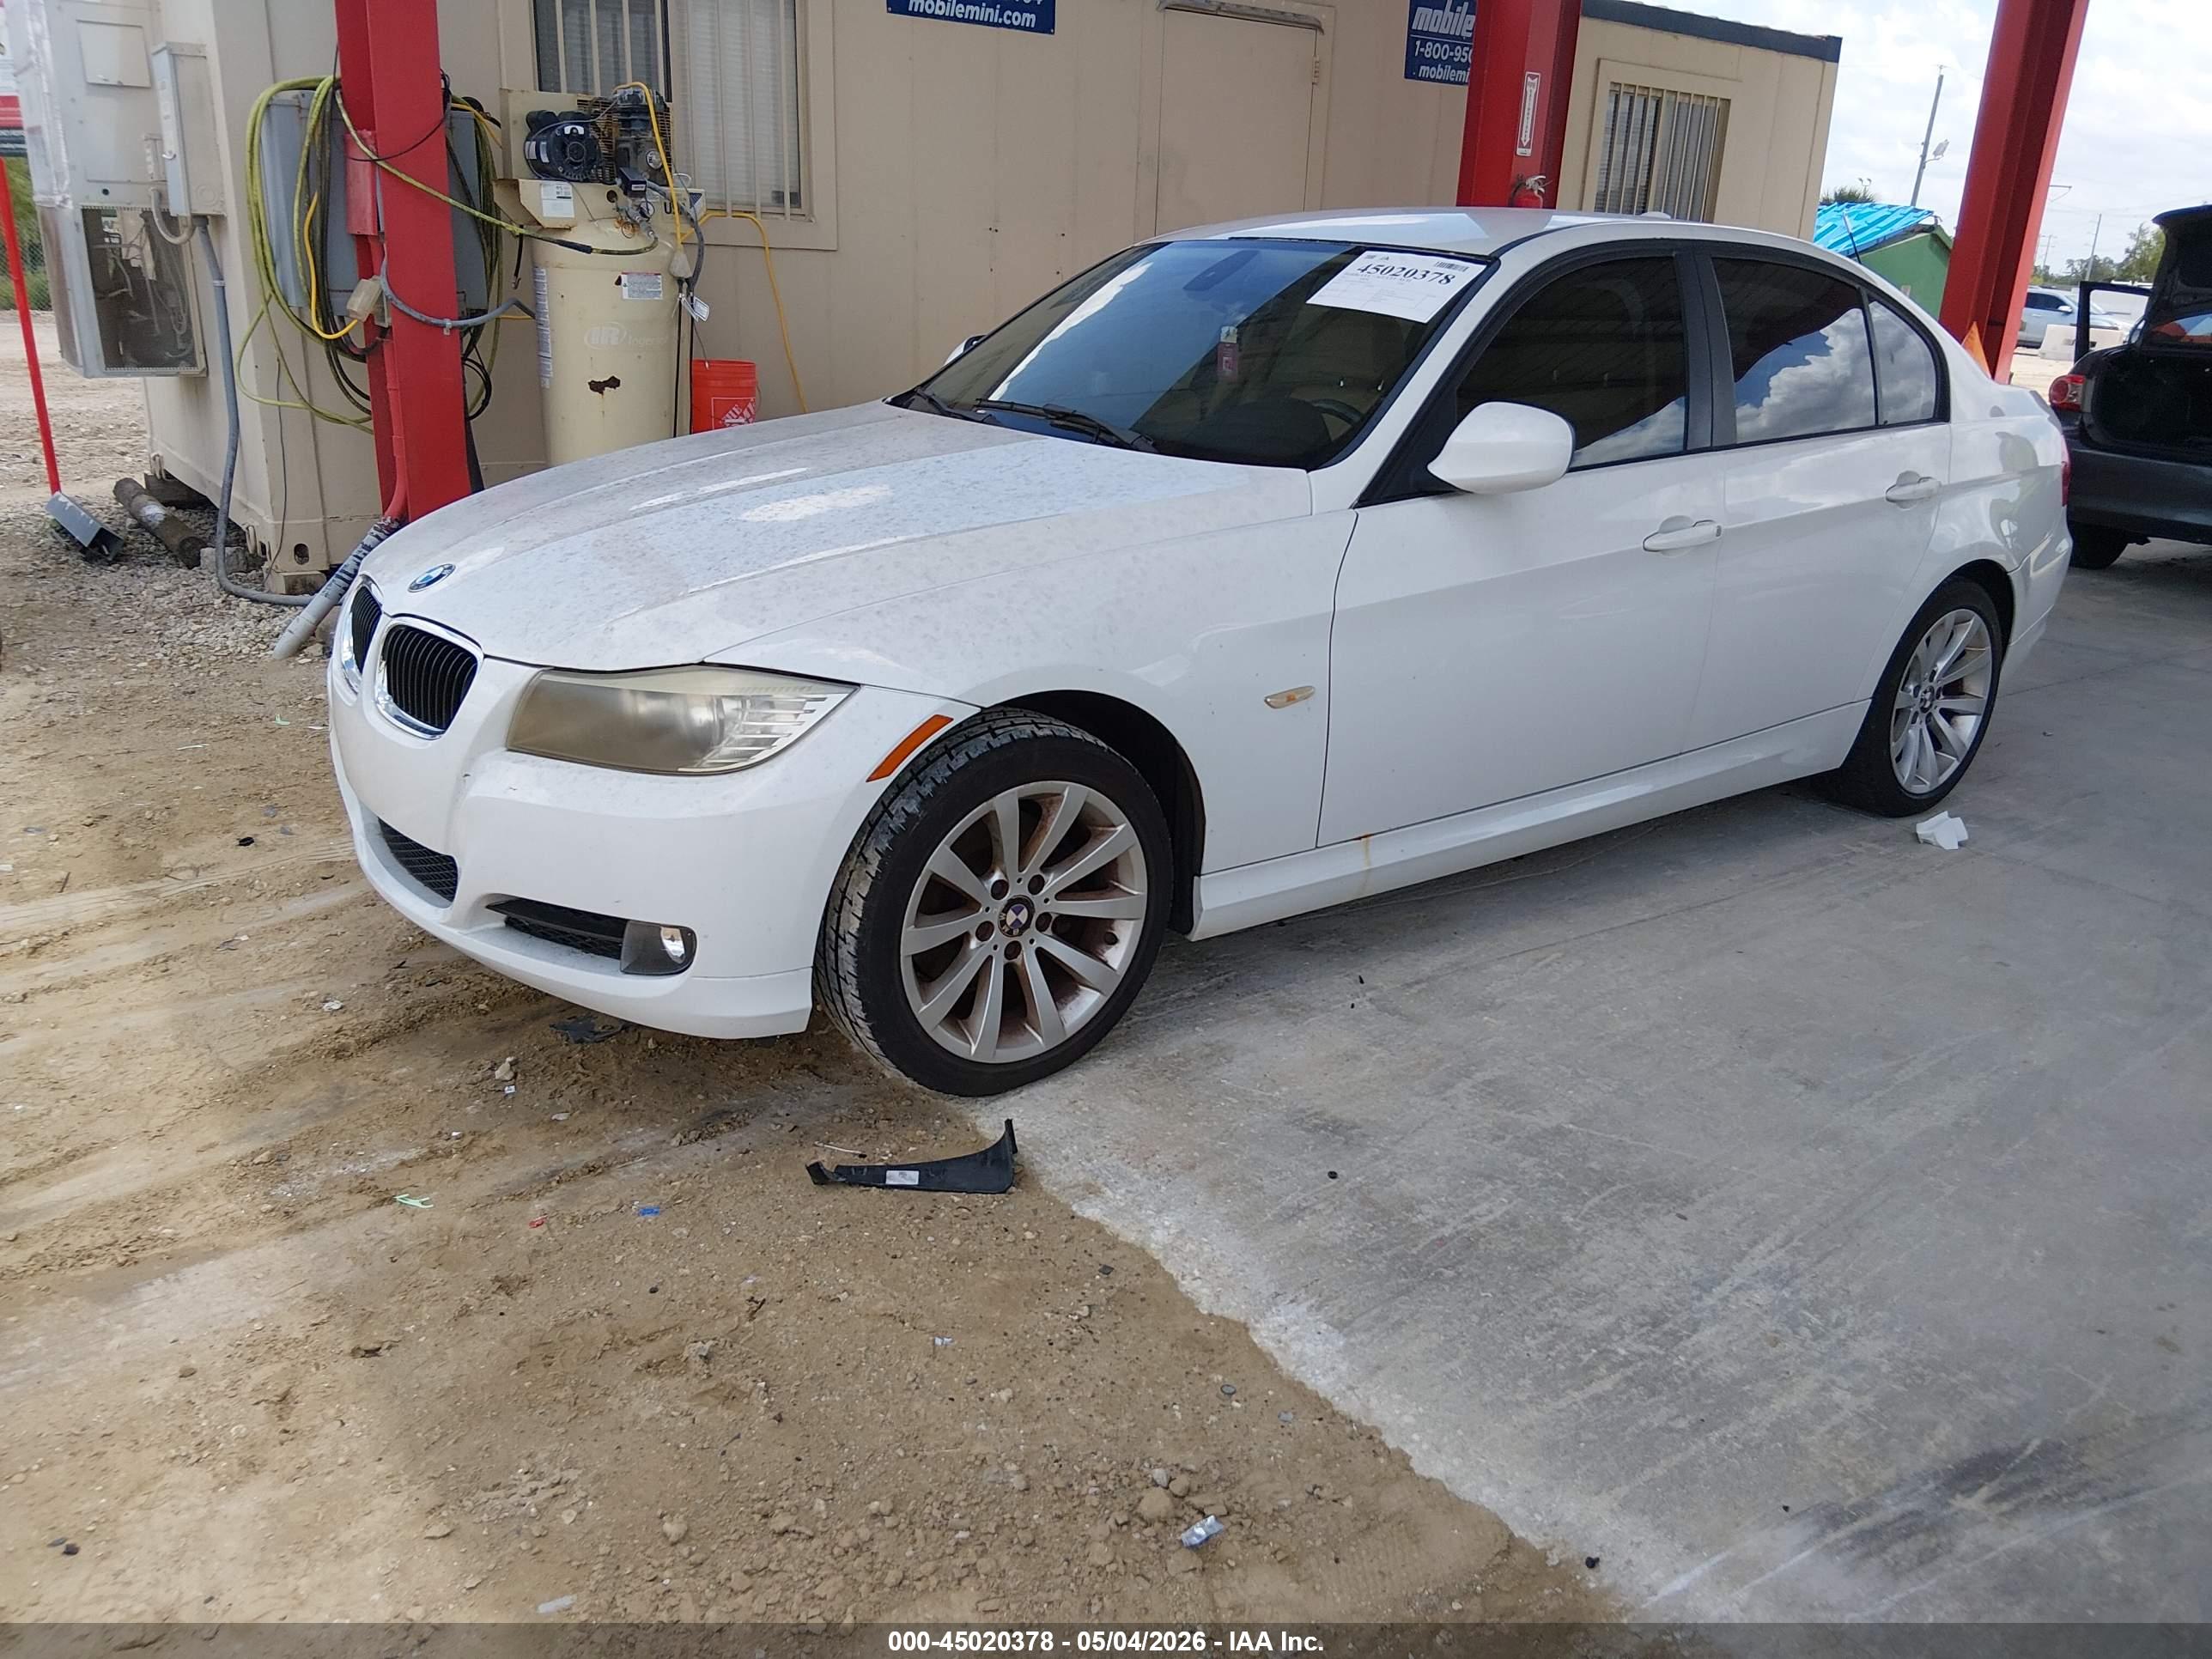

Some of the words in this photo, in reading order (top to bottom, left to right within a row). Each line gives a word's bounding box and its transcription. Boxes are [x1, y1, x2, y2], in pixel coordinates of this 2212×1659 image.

[908, 0, 1036, 27] mobilemini.com
[1412, 0, 1476, 38] mobile
[1357, 263, 1456, 285] 45020378
